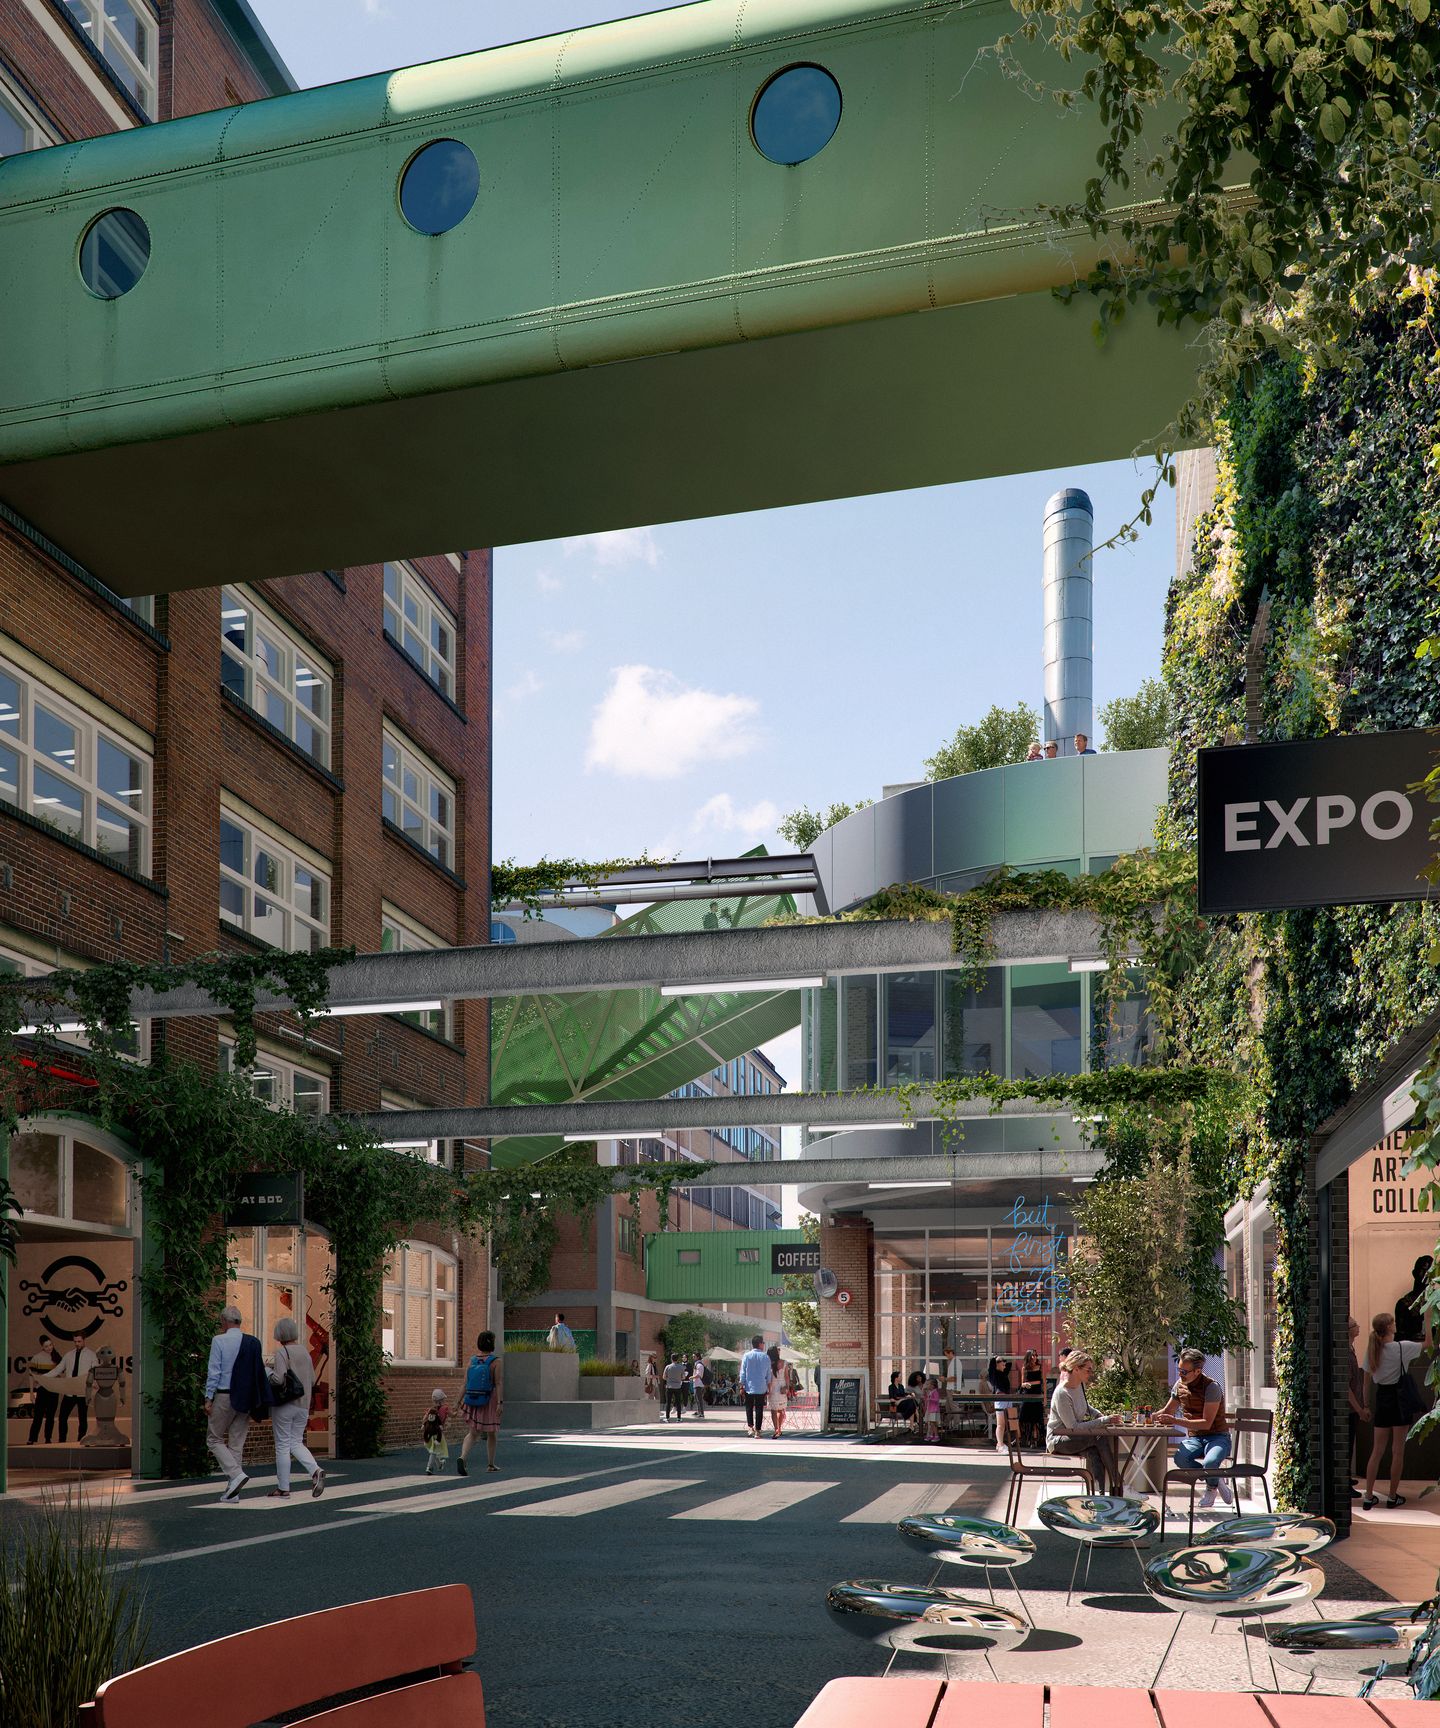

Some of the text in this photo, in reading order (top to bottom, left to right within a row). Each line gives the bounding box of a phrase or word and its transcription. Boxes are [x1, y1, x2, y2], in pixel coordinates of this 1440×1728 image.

[1224, 790, 1413, 852] EXPO
[1372, 1157, 1409, 1182] ART
[777, 1252, 820, 1267] COFFEE
[999, 1231, 1068, 1273] first
[840, 1293, 848, 1302] 5
